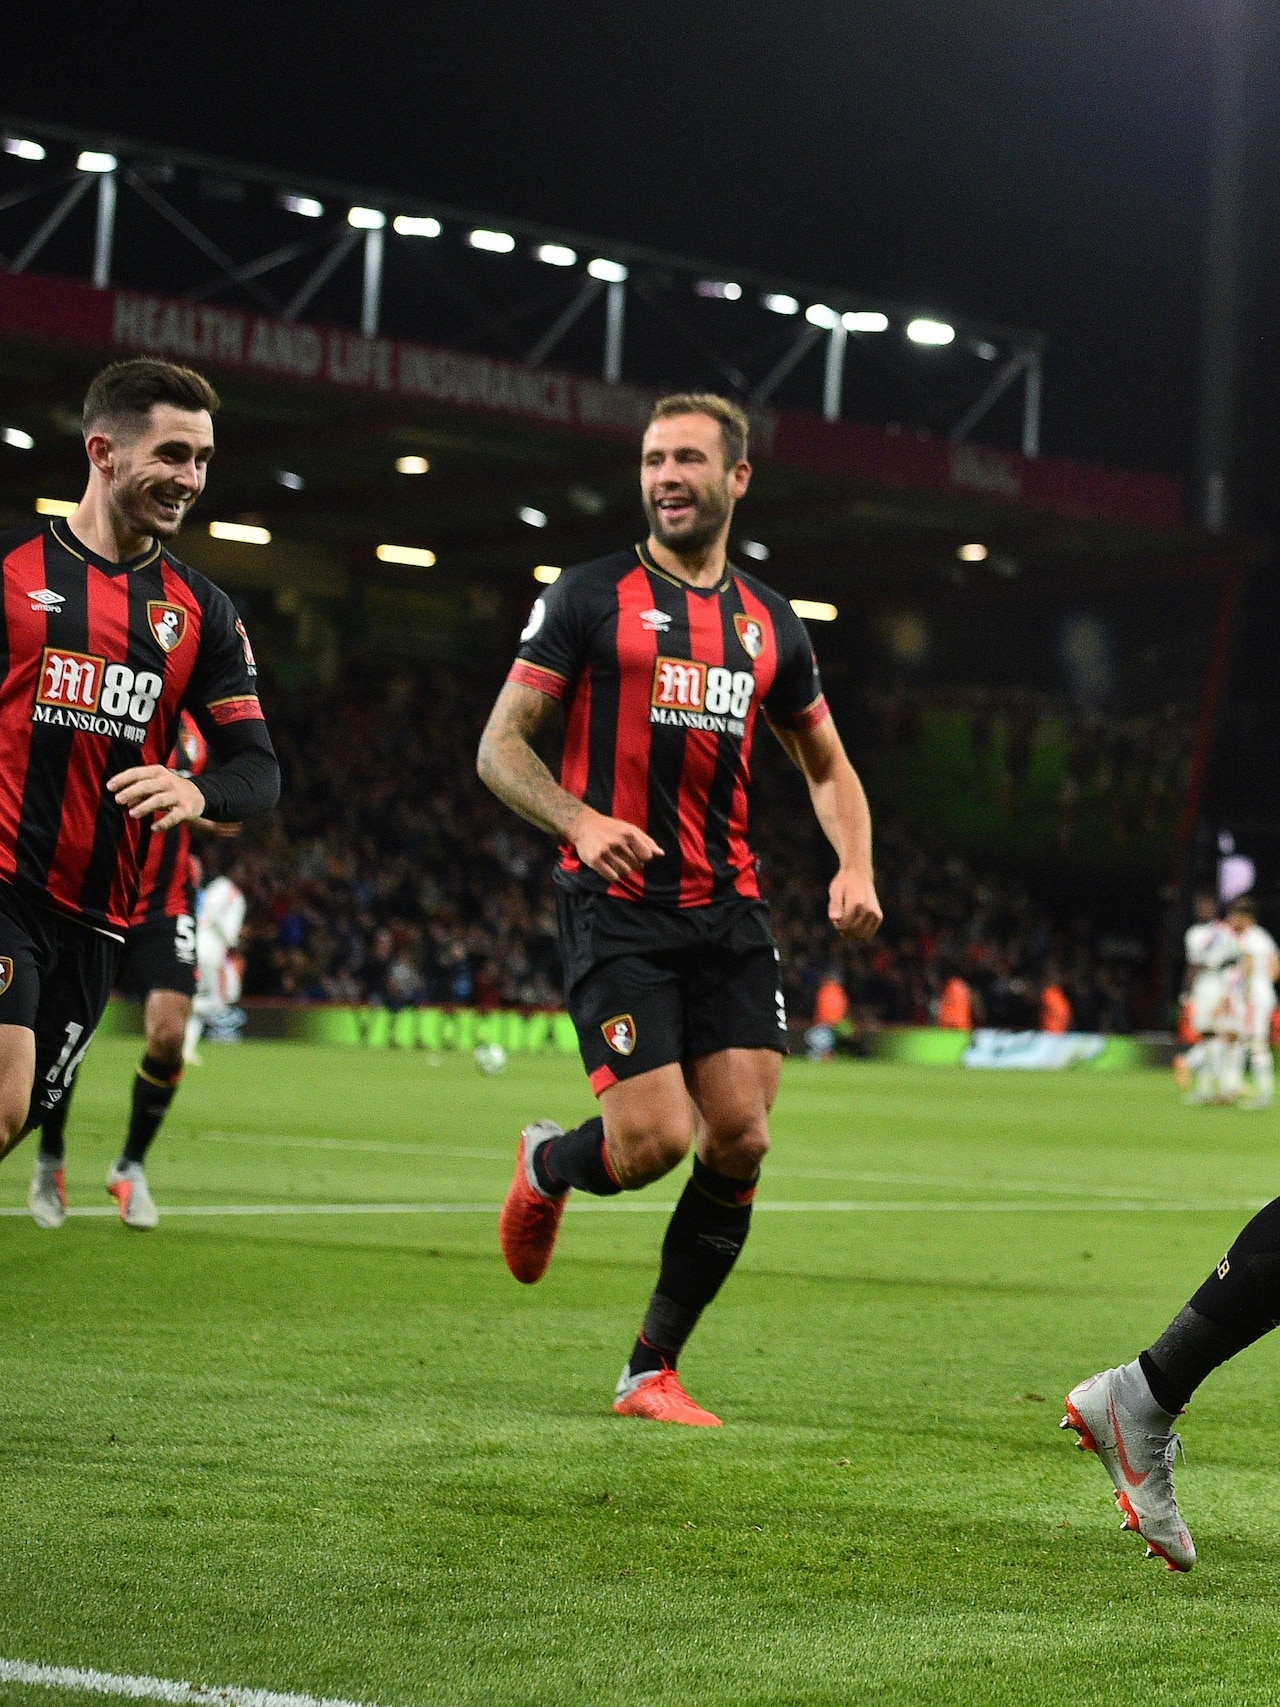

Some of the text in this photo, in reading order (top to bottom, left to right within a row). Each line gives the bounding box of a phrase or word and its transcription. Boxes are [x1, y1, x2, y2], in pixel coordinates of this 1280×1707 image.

[112, 292, 243, 364] HEALTH
[250, 317, 322, 377] AND
[328, 329, 390, 391] LIFE
[399, 346, 570, 423] INSURANCE
[31, 602, 62, 614] umbro
[32, 704, 124, 738] MANSION
[650, 706, 727, 733] MANSION
[173, 914, 196, 951] 5
